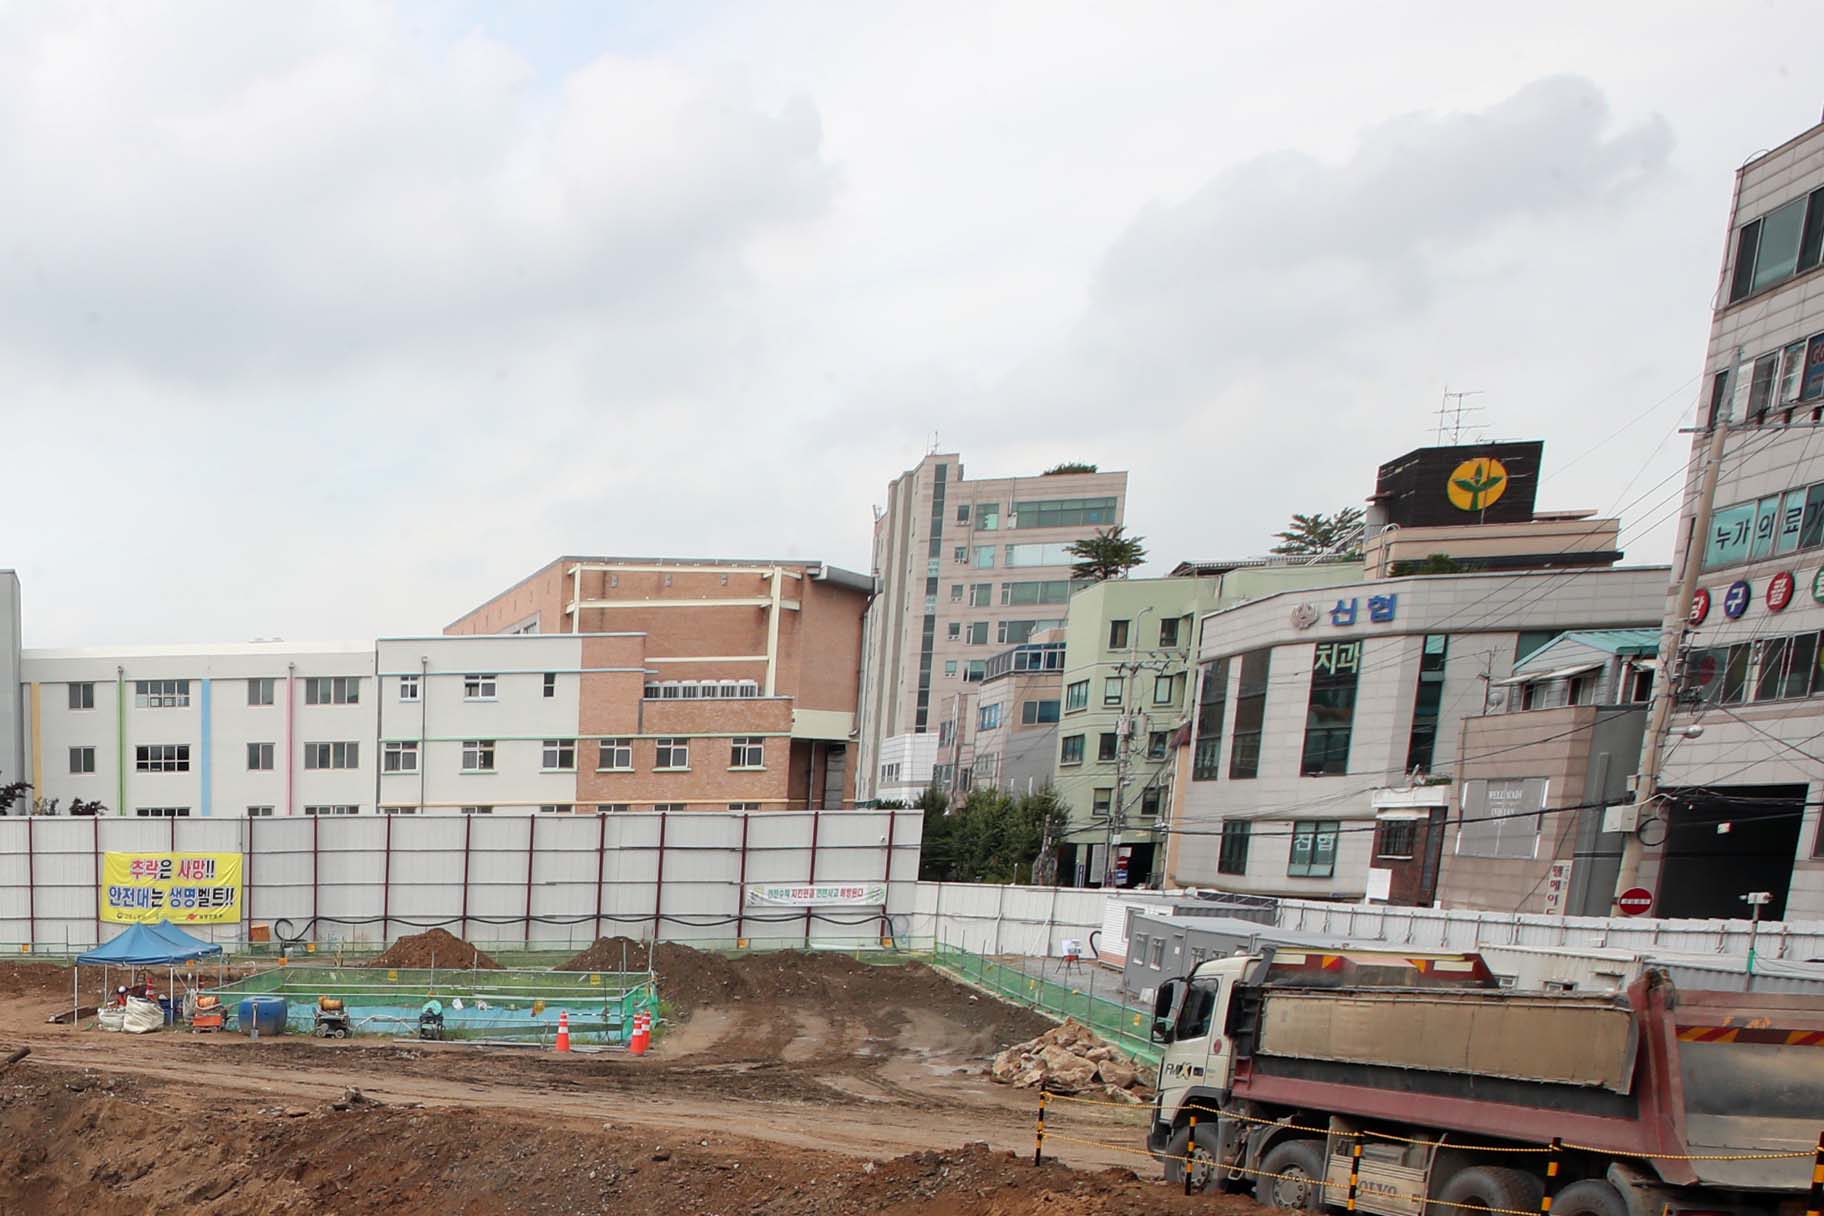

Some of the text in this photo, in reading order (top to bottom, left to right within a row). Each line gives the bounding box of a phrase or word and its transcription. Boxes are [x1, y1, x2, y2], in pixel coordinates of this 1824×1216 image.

[1328, 593, 1397, 627] 신협
[1314, 641, 1360, 675] 치과
[131, 859, 215, 880] 추락은 사망!!
[109, 887, 235, 908] 안전대는 생명벨트!!
